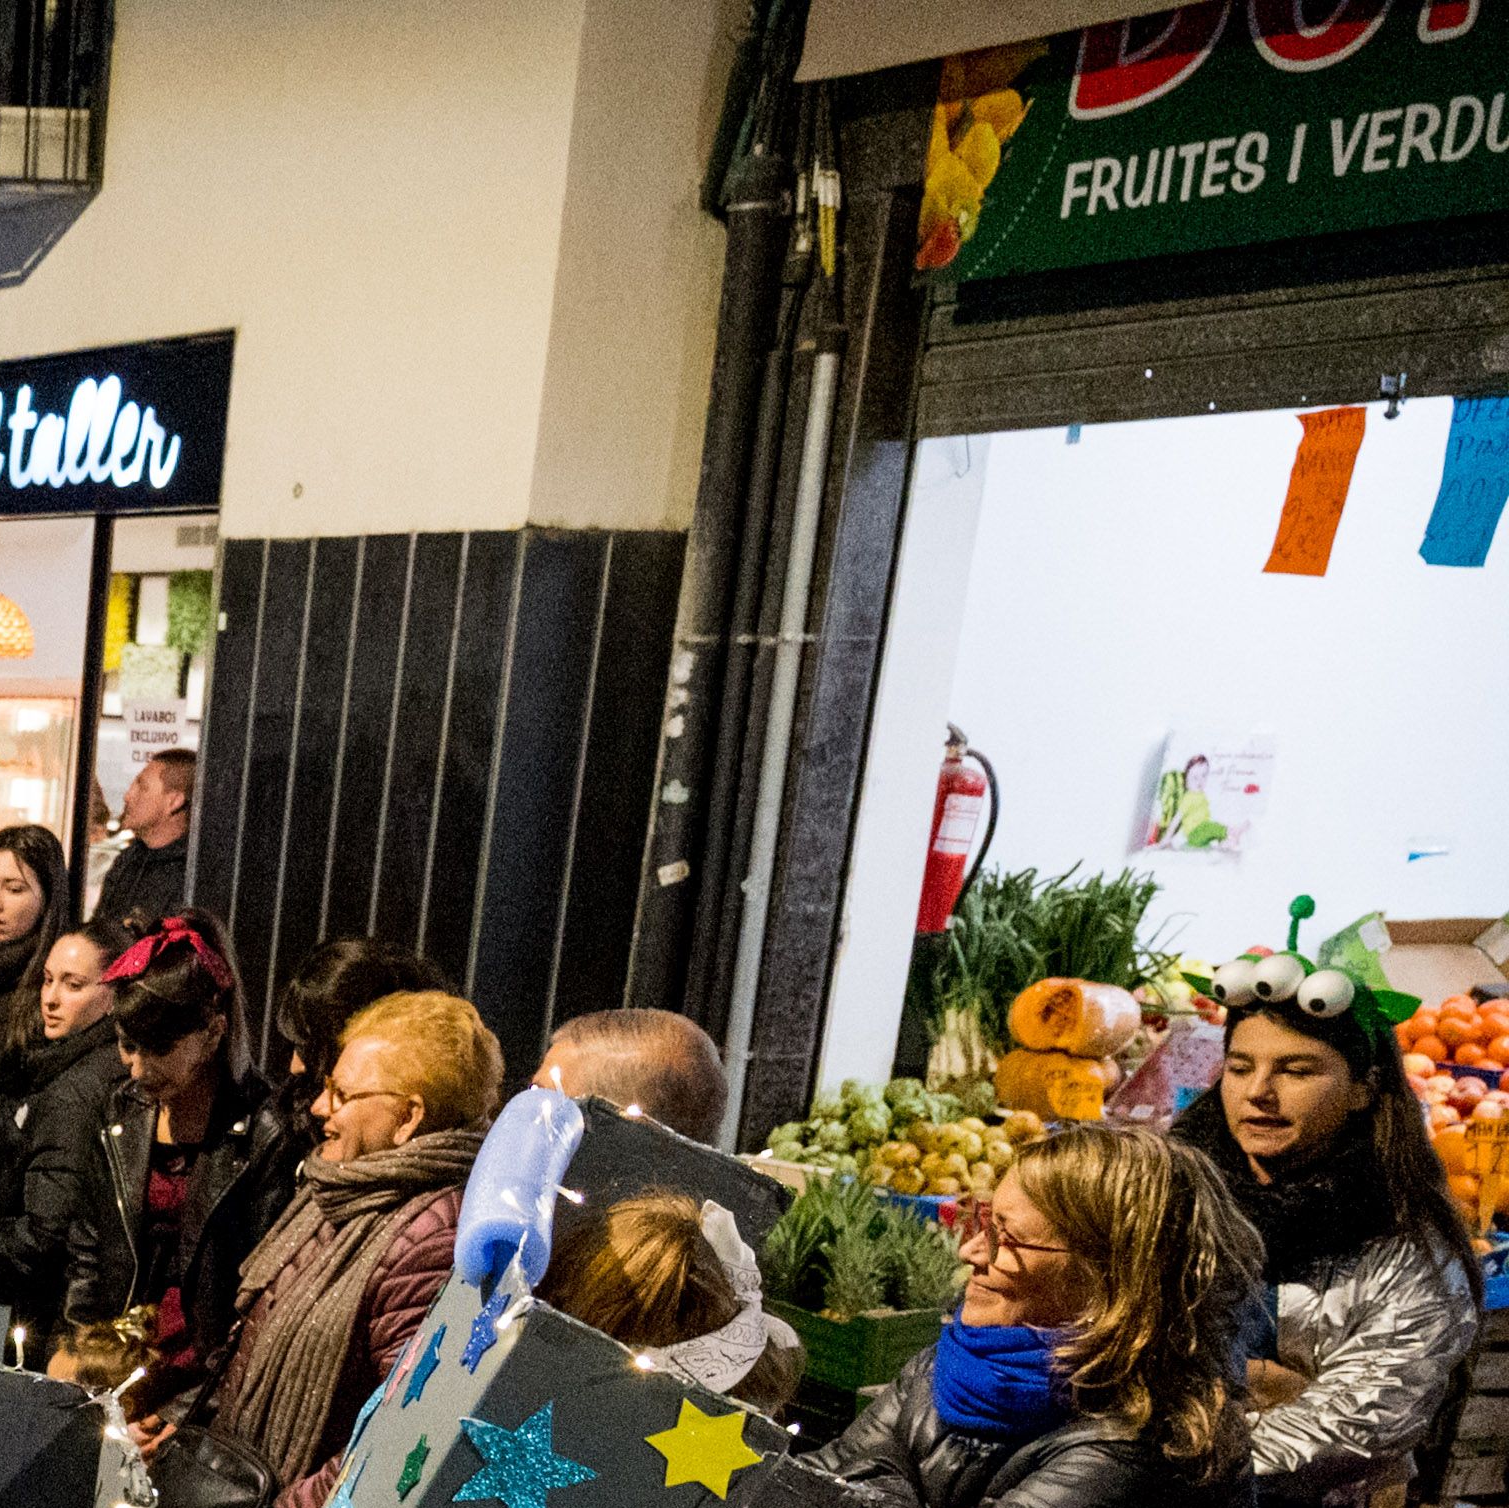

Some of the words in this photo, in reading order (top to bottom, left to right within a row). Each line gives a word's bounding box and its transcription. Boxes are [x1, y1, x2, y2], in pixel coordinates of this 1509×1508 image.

[1060, 131, 1271, 220] FRUITES
[1287, 123, 1308, 184] I
[7, 373, 183, 490] taller
[134, 710, 177, 724] LAVABOS
